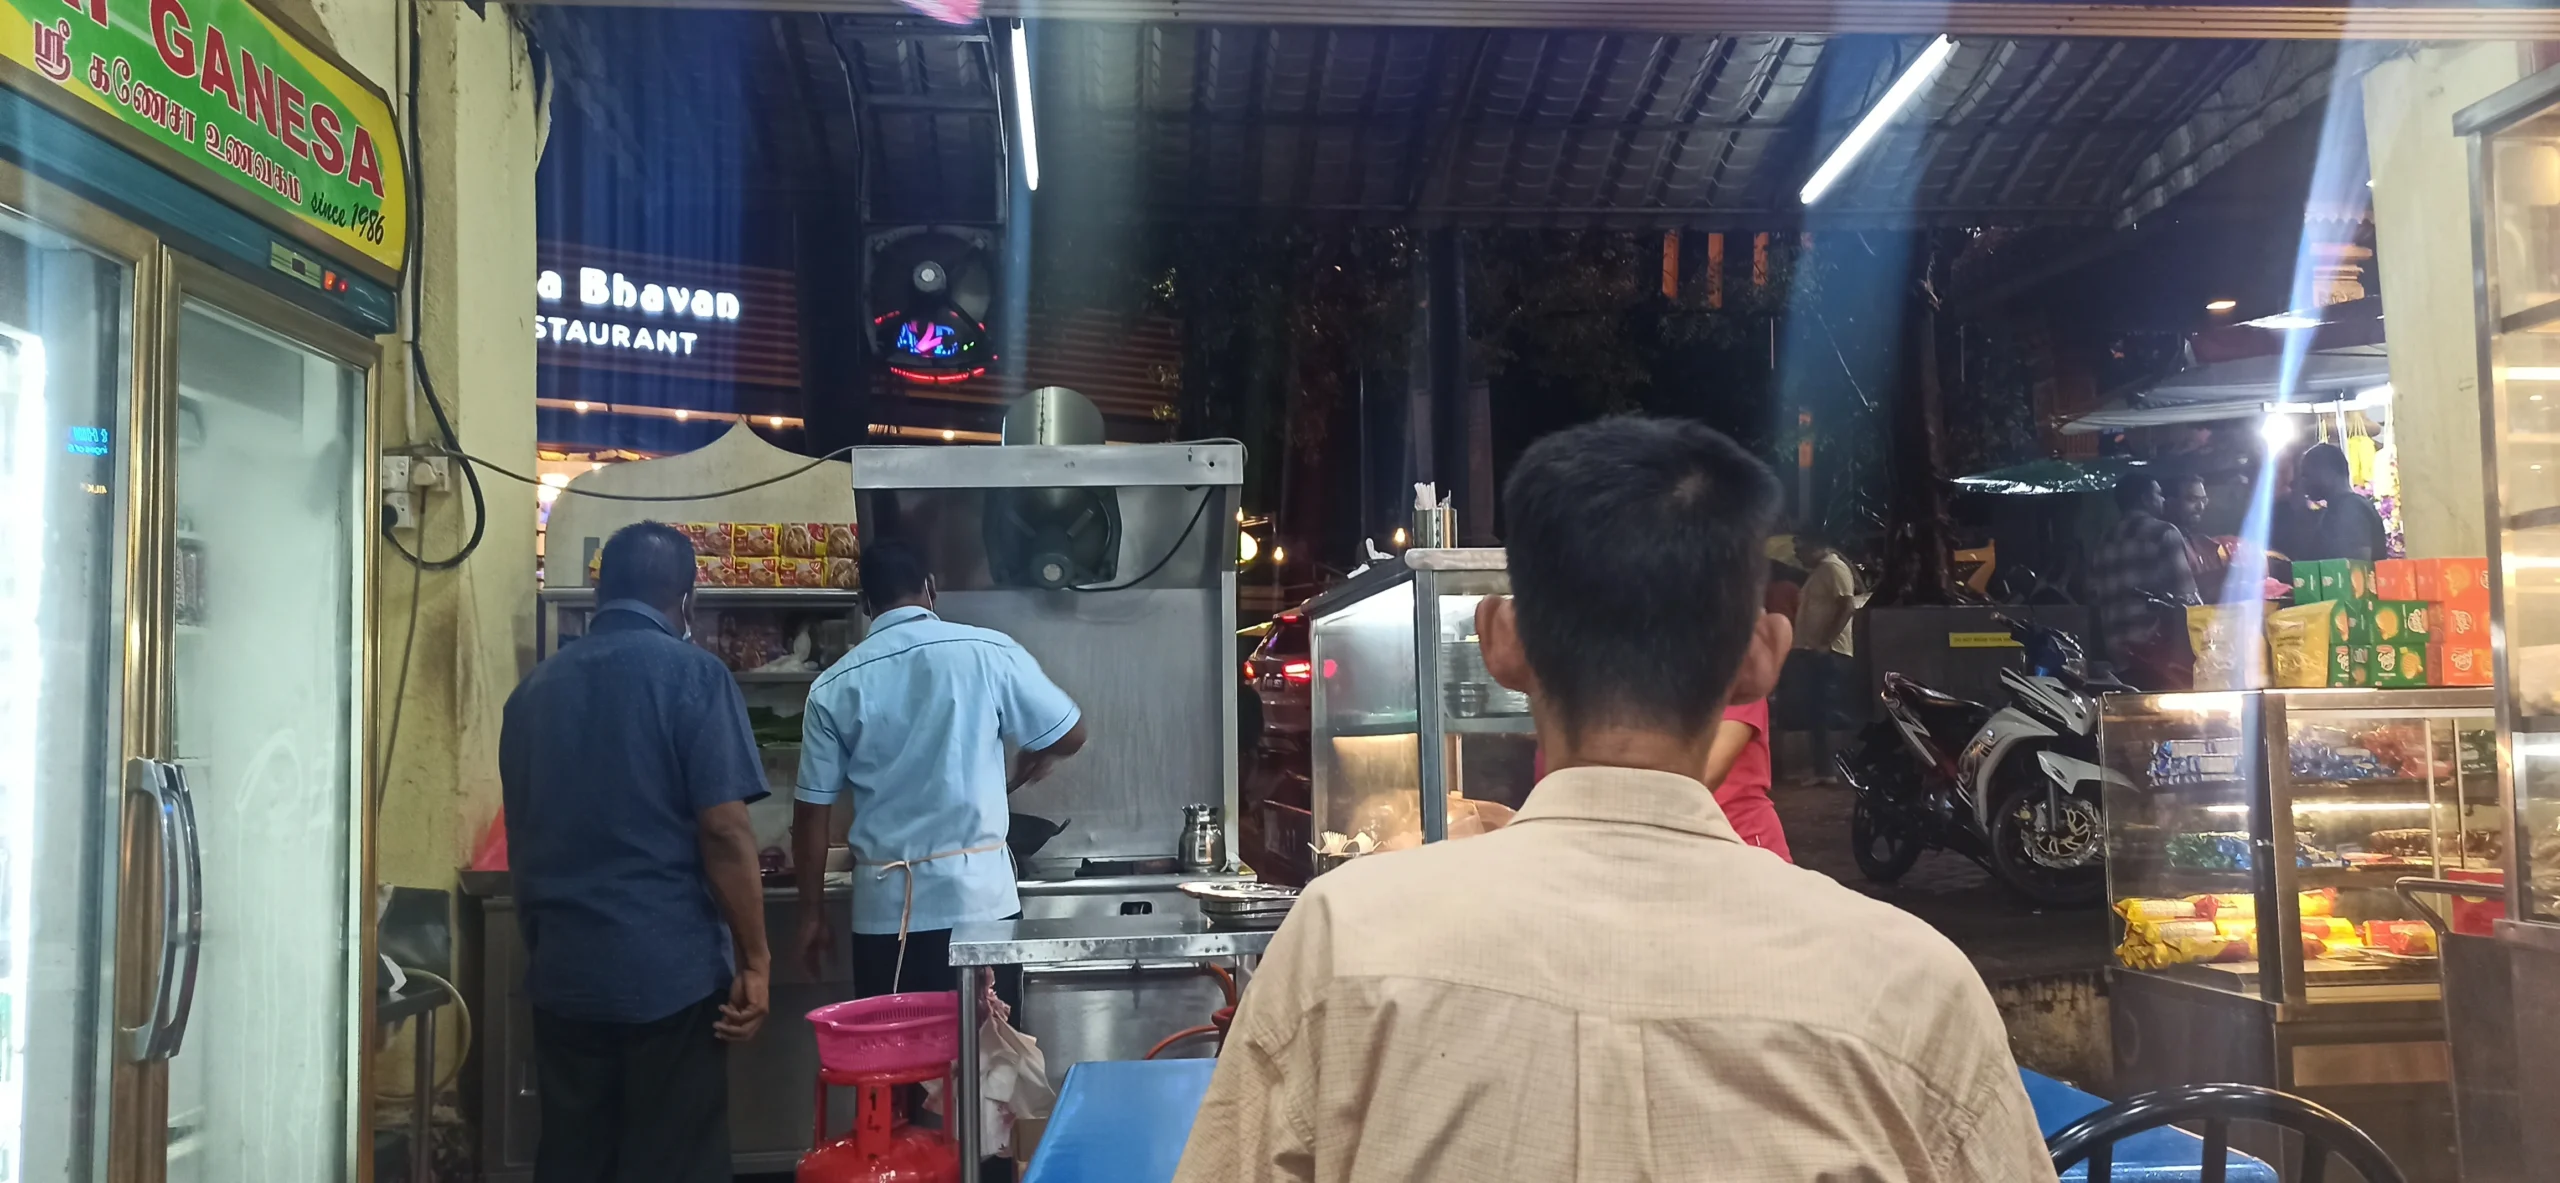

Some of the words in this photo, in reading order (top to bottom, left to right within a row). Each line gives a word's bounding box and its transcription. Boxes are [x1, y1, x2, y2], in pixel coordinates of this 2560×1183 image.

[88, 52, 197, 144] கணேசா
[204, 122, 303, 206] உணவகம்
[149, 0, 386, 200] GANESA
[310, 191, 348, 229] since
[350, 201, 386, 246] 1986
[579, 266, 740, 320] Bhavan
